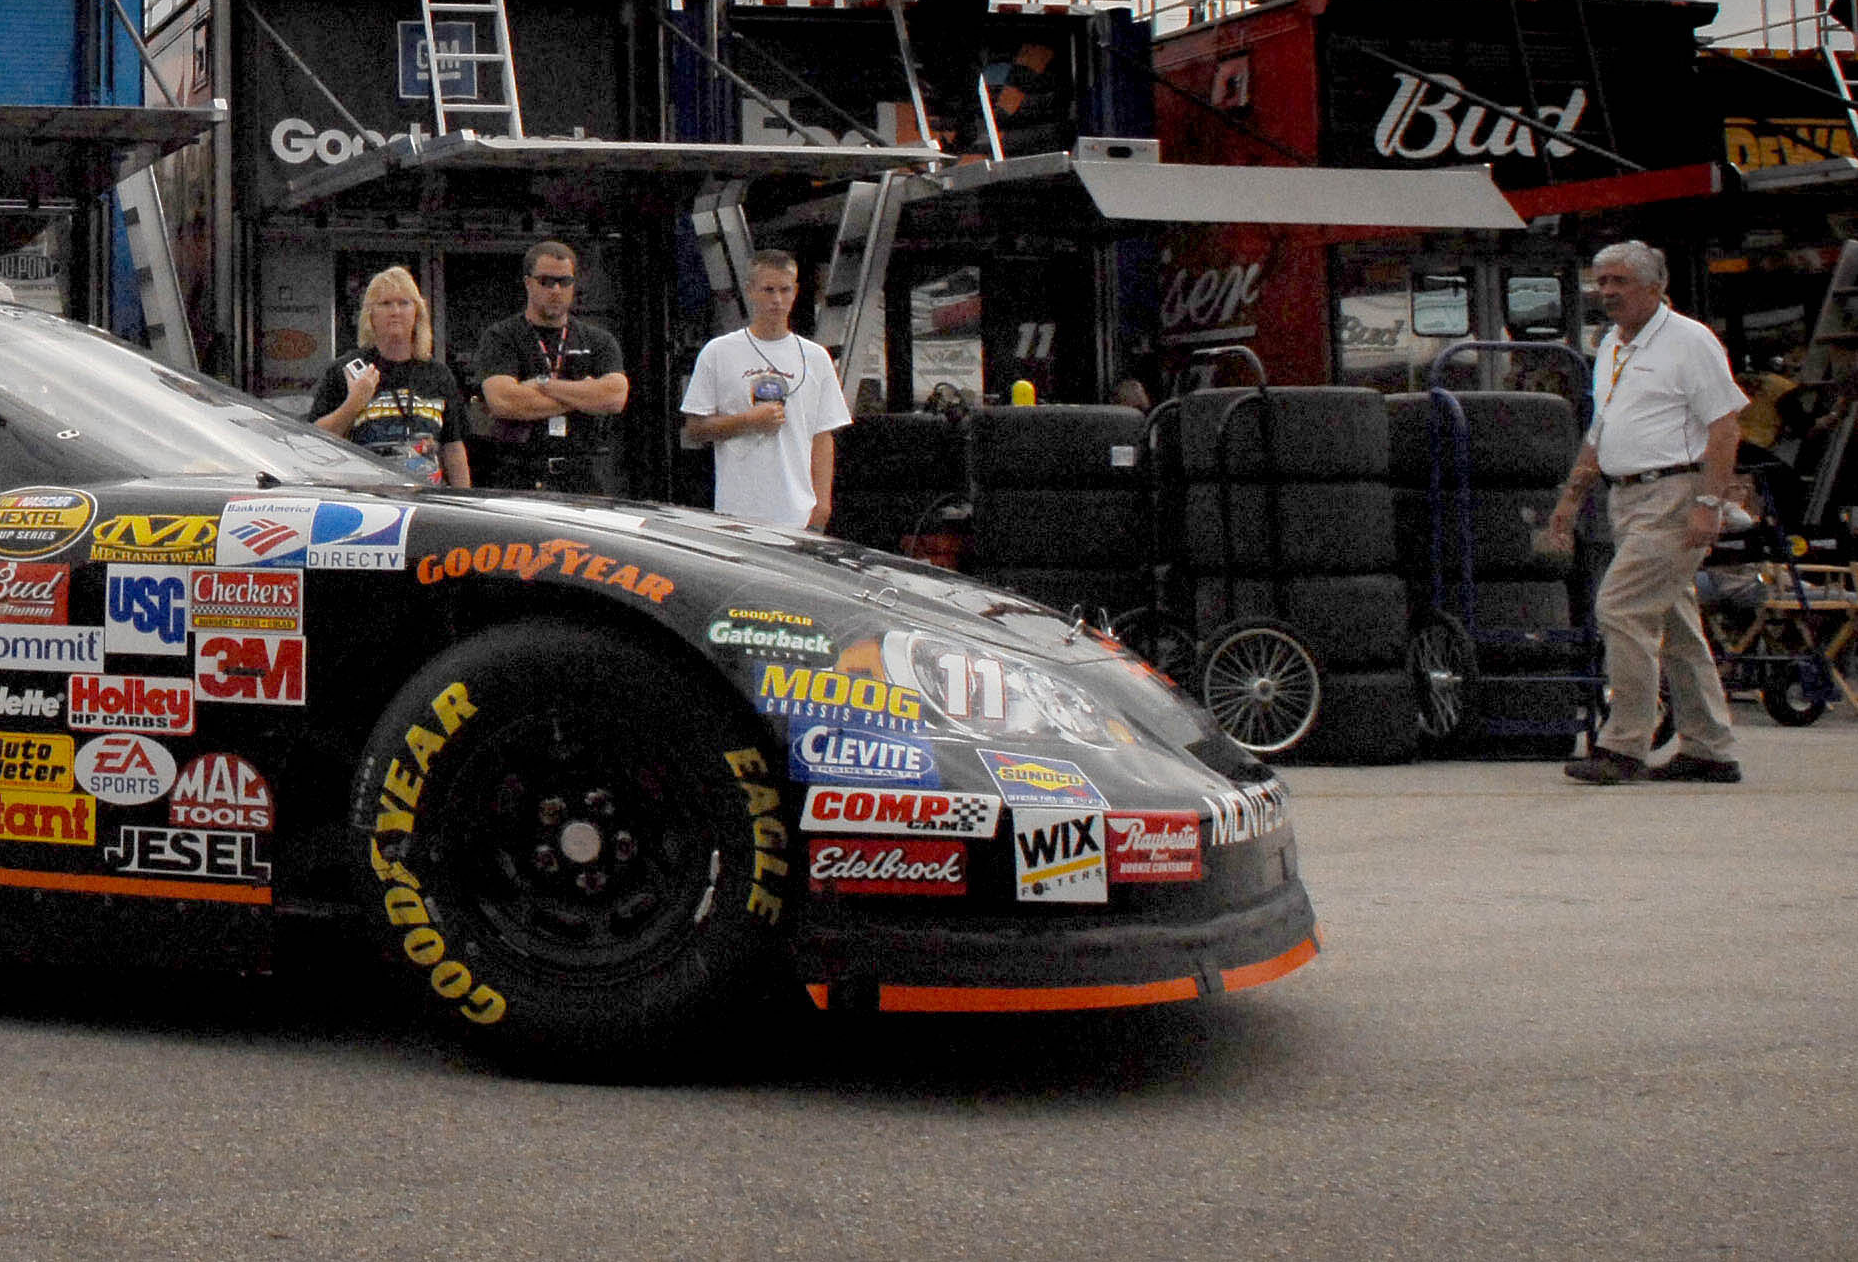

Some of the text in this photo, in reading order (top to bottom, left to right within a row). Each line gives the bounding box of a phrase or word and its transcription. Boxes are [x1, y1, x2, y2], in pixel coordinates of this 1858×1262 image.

[1374, 72, 1588, 159] Bud
[17, 530, 57, 540] SERIES
[309, 551, 399, 568] DIRECTV
[417, 538, 674, 604] GOODYEAR
[194, 573, 293, 605] Checkers
[109, 576, 185, 644] USG
[728, 608, 813, 626] GOODYEAR
[709, 620, 833, 655] Gatorback
[199, 636, 303, 700] 3M
[939, 652, 1006, 721] 11
[71, 676, 190, 729] Holley
[760, 664, 922, 721] MOOG
[71, 713, 168, 728] HP CARBS
[766, 698, 919, 734] CHASSIS PARTS
[93, 738, 157, 776] EA
[800, 725, 922, 771] CLEVITE
[91, 775, 160, 795] SPORTS
[174, 755, 269, 806] MAC
[1000, 766, 1083, 787] SUNOCO
[172, 805, 270, 828] TOOLS
[811, 791, 950, 823] COMP
[906, 820, 975, 832] CAMS
[104, 825, 272, 878] JESEL
[370, 681, 507, 1025] GOODYEAR
[723, 747, 789, 926] EAGLE
[1017, 815, 1102, 869] WIX
[810, 846, 962, 883] Edelbrock
